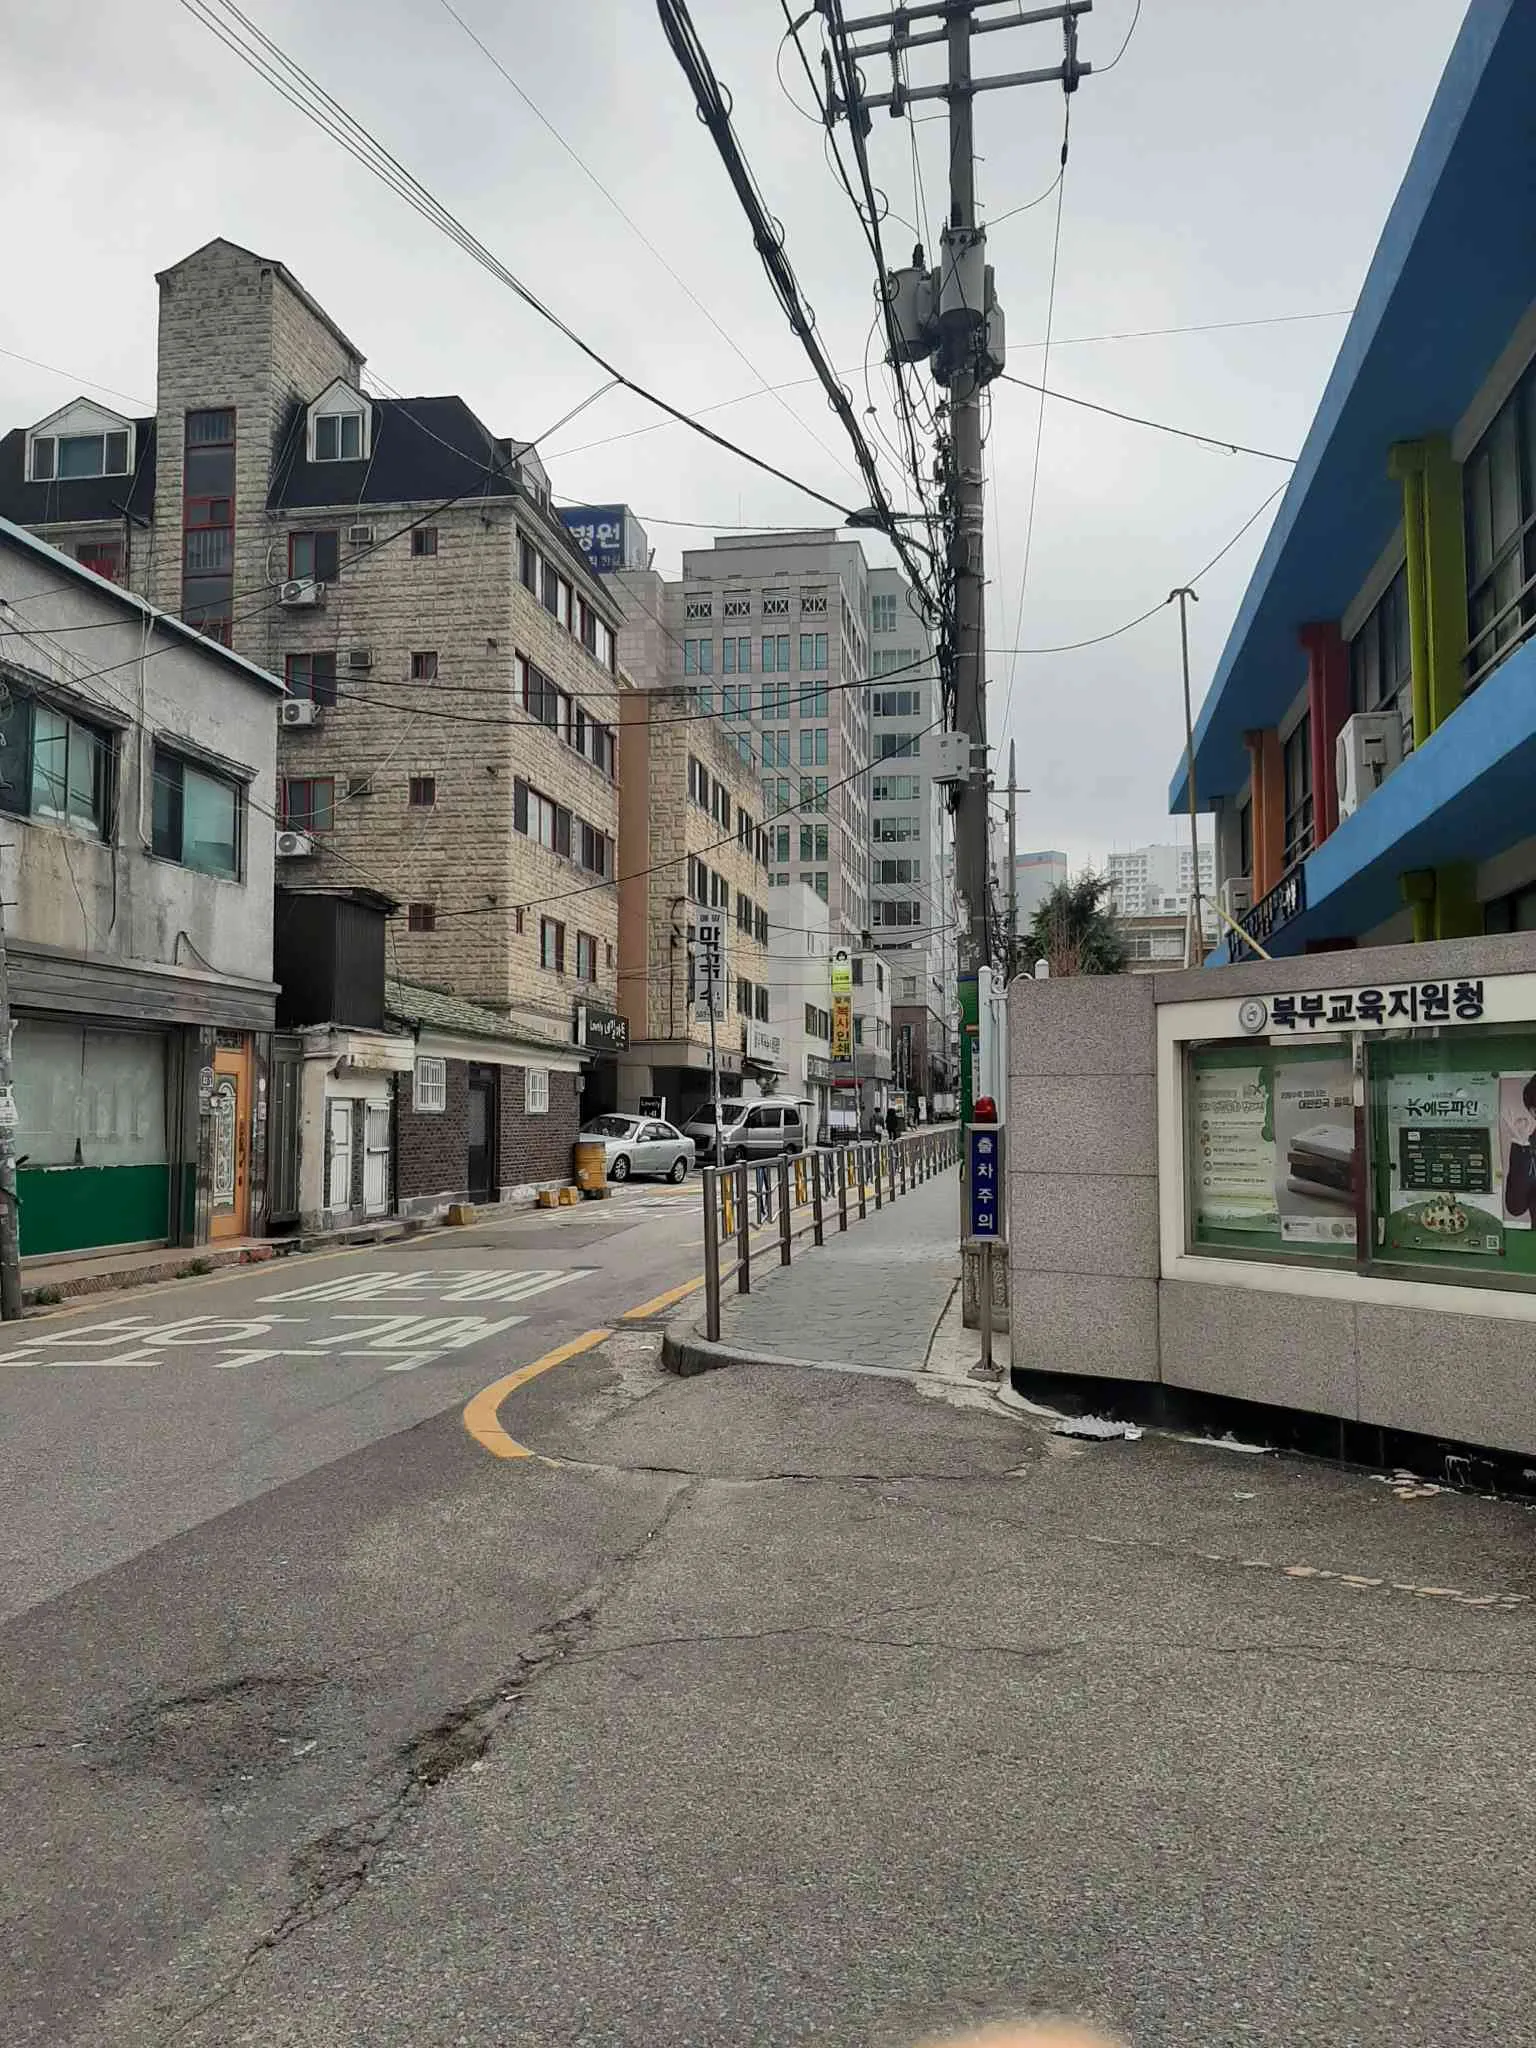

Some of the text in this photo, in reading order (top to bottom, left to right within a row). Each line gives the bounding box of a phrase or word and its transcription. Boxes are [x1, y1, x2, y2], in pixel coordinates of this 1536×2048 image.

[569, 523, 621, 552] 병원
[1271, 980, 1485, 1028] 북부교육지원청
[976, 1137, 995, 1230] 출차주의
